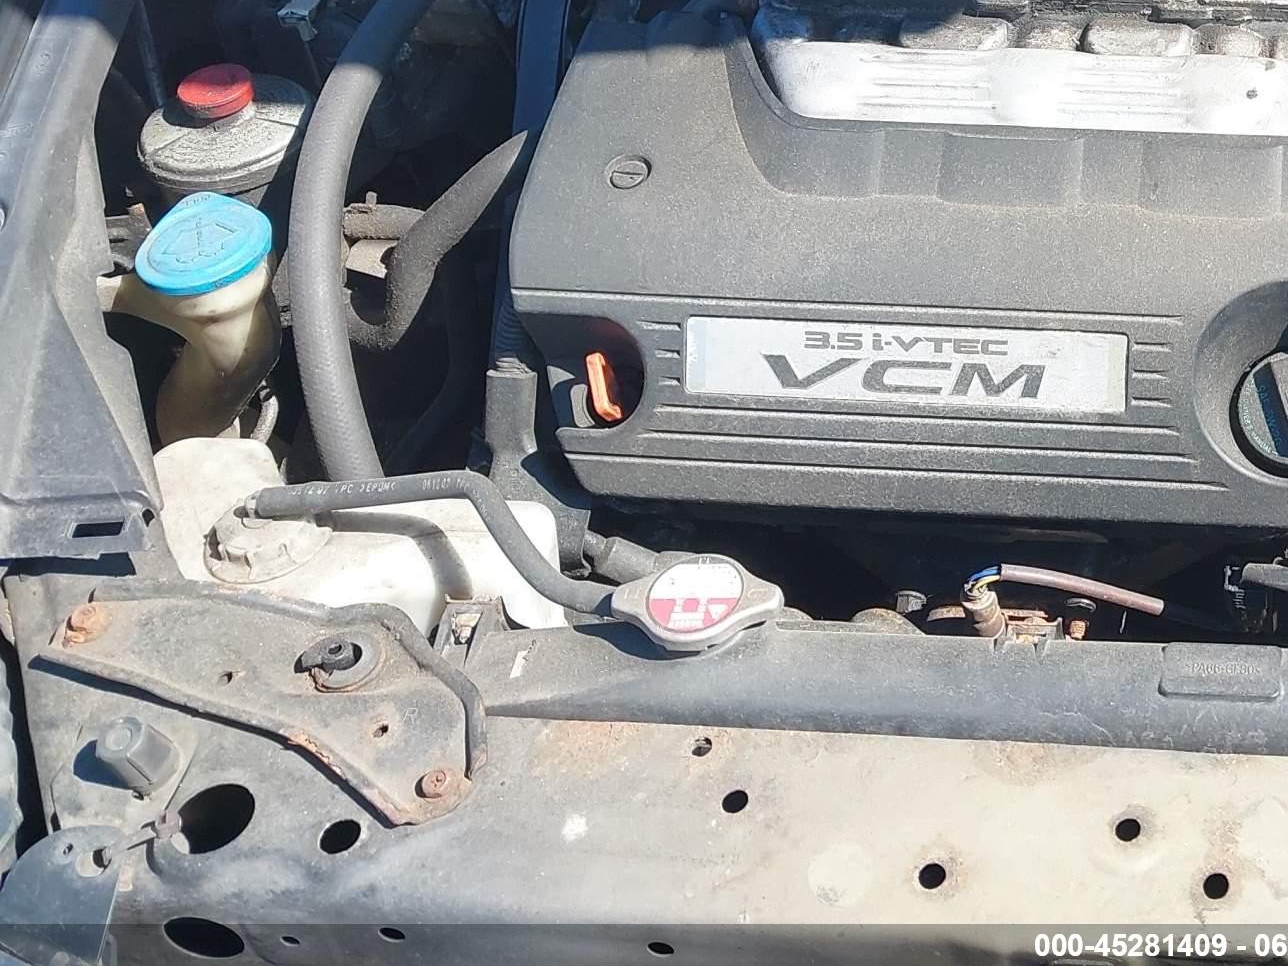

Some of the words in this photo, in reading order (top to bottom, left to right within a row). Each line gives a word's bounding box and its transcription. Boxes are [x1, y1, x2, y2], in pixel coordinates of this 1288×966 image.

[804, 330, 864, 351] 3.5
[871, 332, 1009, 356] i-VTEC
[762, 353, 1046, 399] VCM
